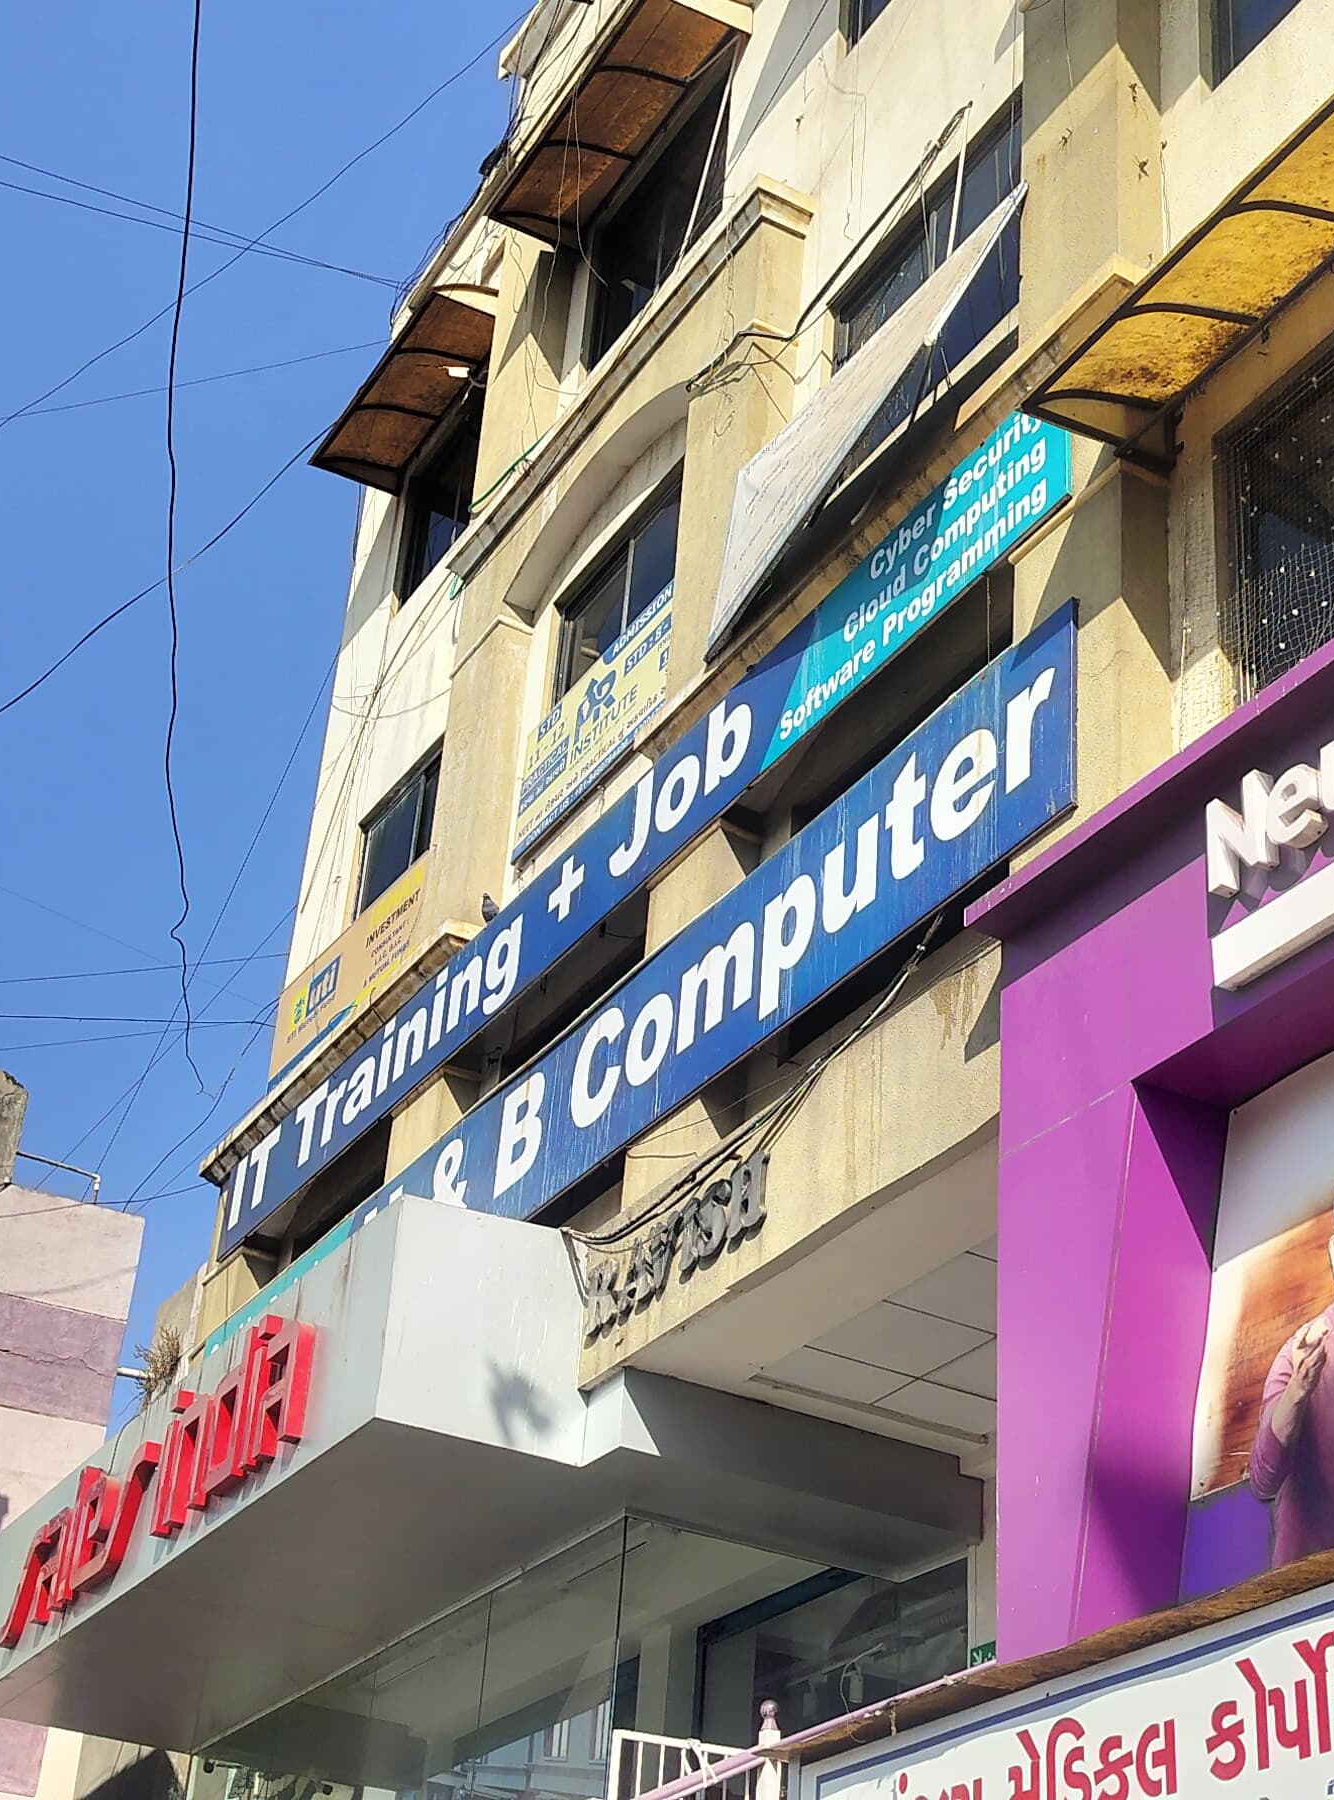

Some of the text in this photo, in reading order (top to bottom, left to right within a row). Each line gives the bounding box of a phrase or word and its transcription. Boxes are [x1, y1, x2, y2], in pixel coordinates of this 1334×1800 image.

[843, 437, 1047, 643] Cloud Computing
[870, 506, 937, 580] Cyber
[612, 585, 672, 656] ADMISSION
[779, 638, 876, 740] Software
[882, 478, 1047, 647] Programming
[539, 706, 562, 738] STD
[570, 684, 638, 764] INSTITUTE
[366, 888, 421, 948] INVESTMENT
[493, 1071, 545, 1199] B
[570, 666, 1055, 1131] Computer
[227, 1124, 285, 1231] IT
[295, 920, 523, 1168] Training
[548, 855, 585, 922] +
[609, 702, 752, 877] Job
